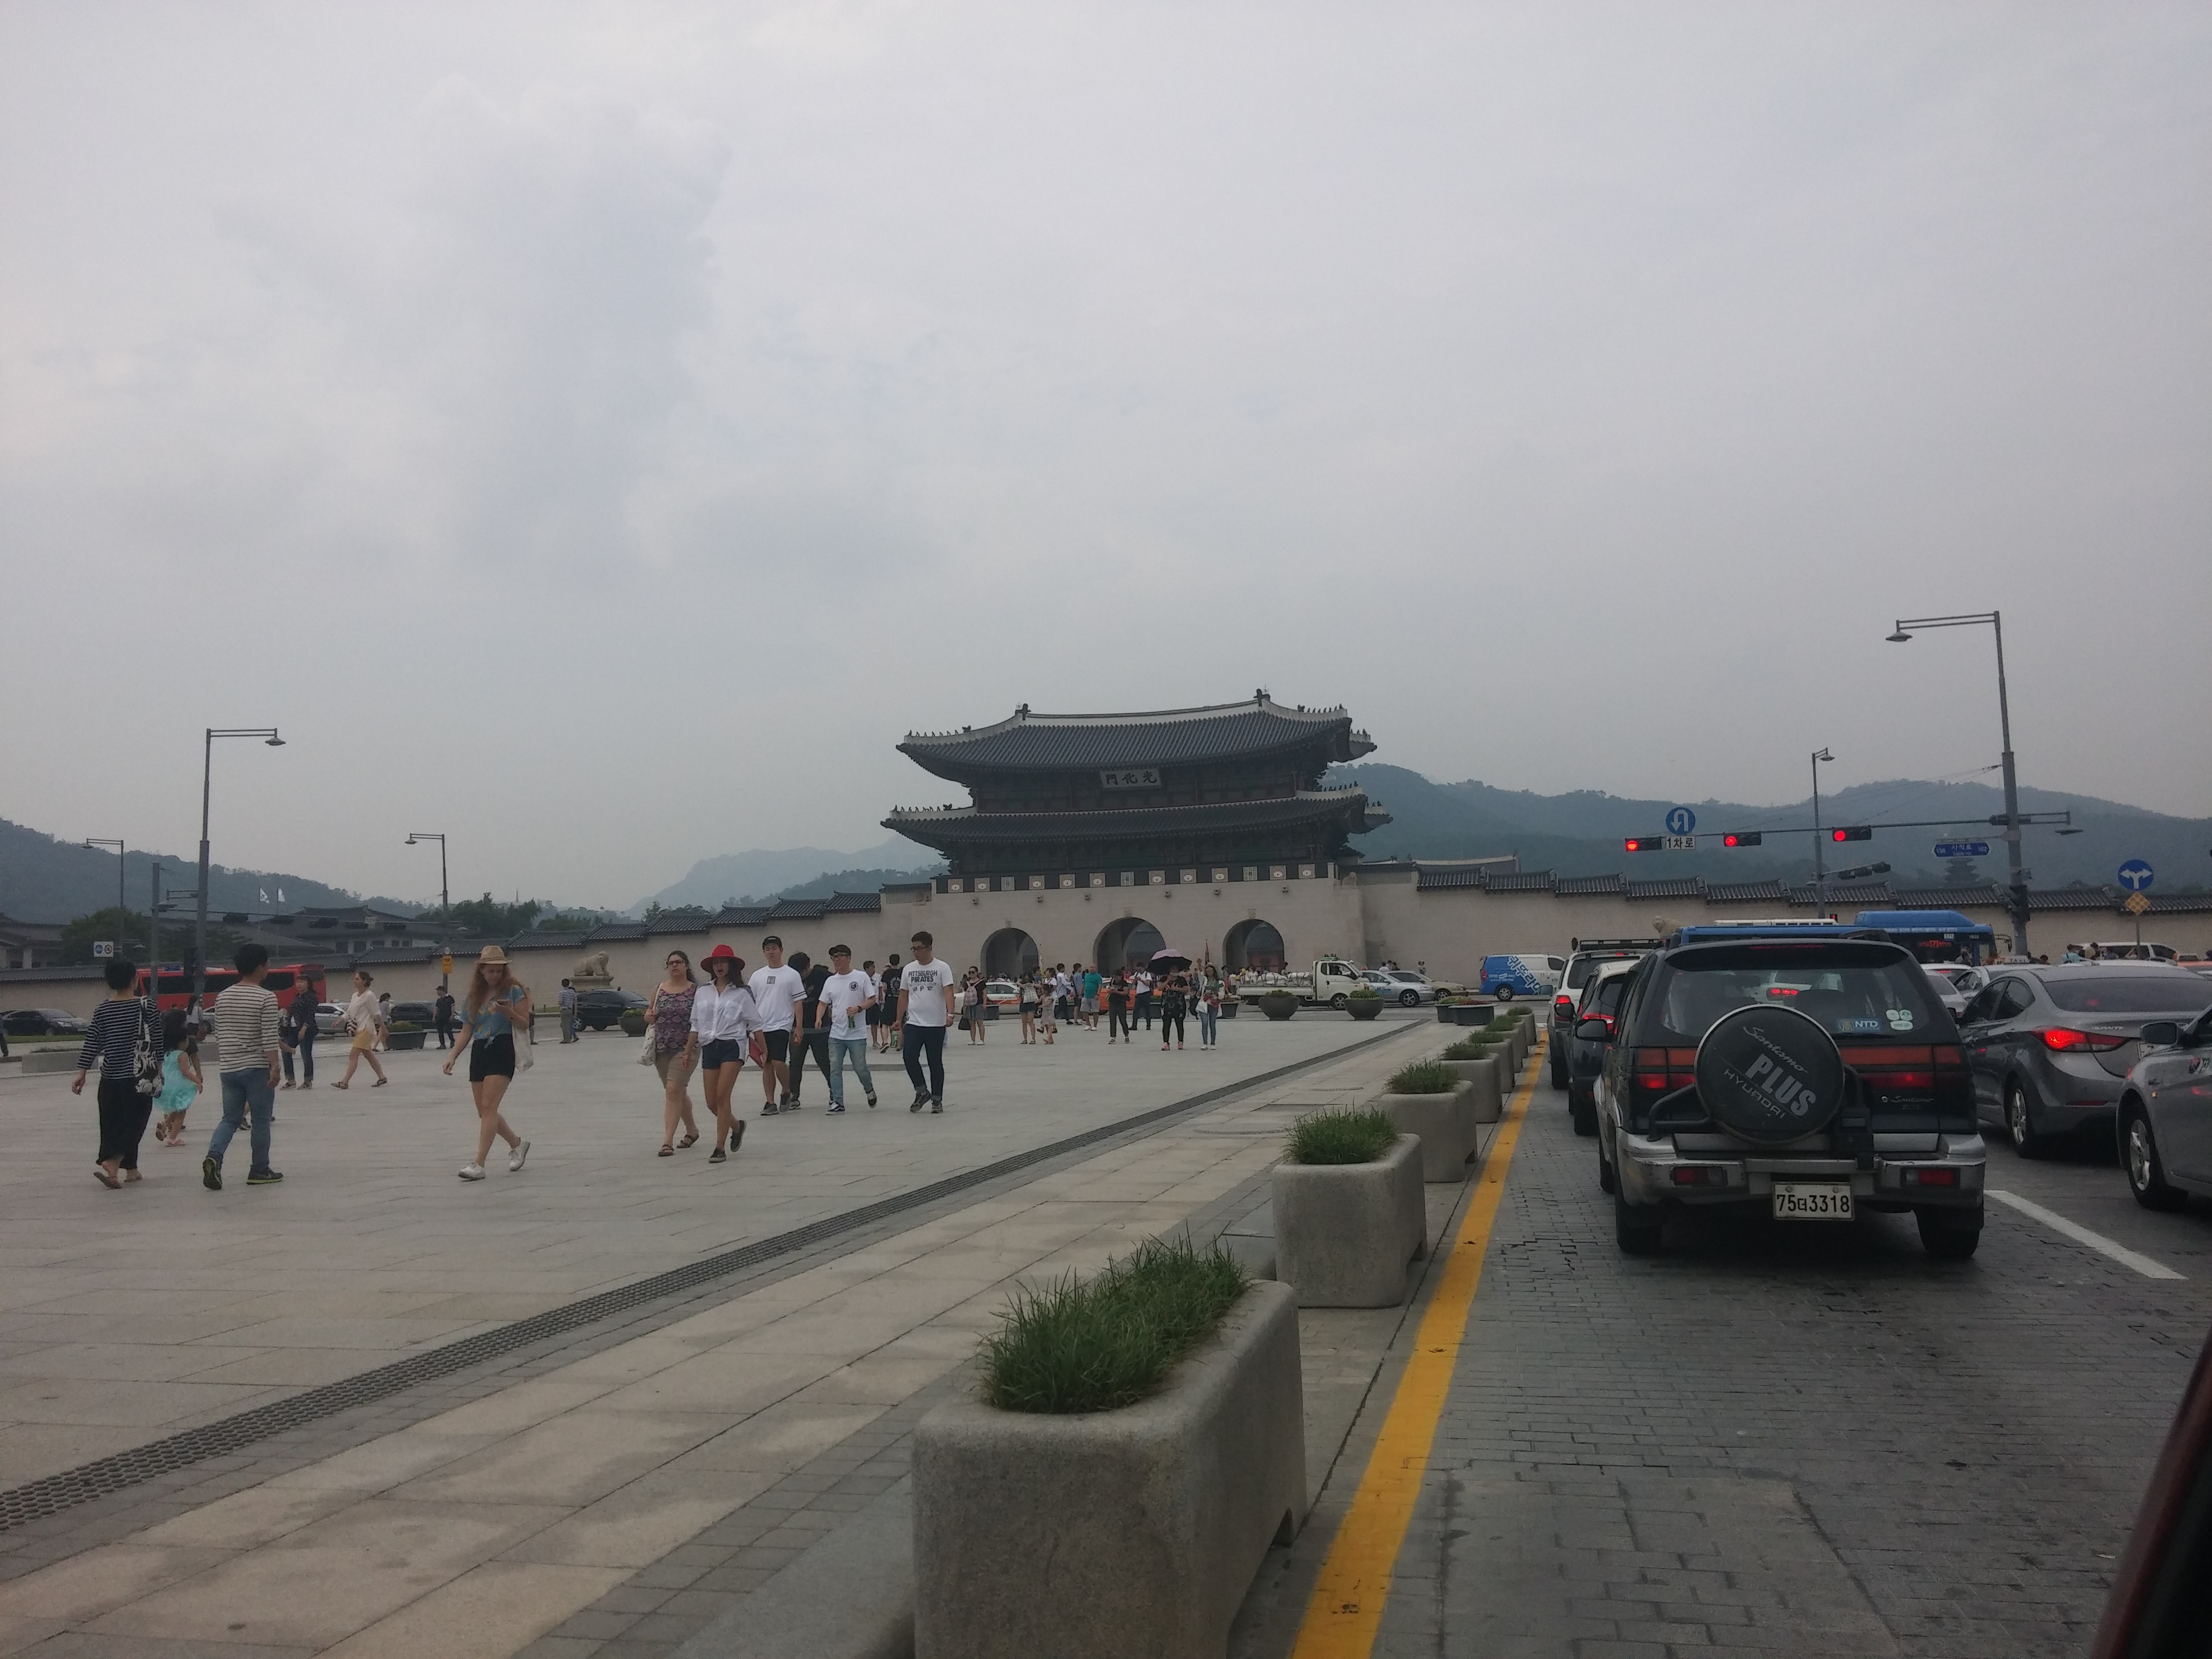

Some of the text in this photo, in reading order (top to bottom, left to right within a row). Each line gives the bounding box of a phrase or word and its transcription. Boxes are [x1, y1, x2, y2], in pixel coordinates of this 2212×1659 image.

[1668, 837, 1694, 849] 1차로
[1742, 1026, 1809, 1074] Santamo
[1723, 1069, 1786, 1119] HYUNDAI
[1745, 1053, 1816, 1117] PLUS
[1777, 1194, 1849, 1212] 75더3318
